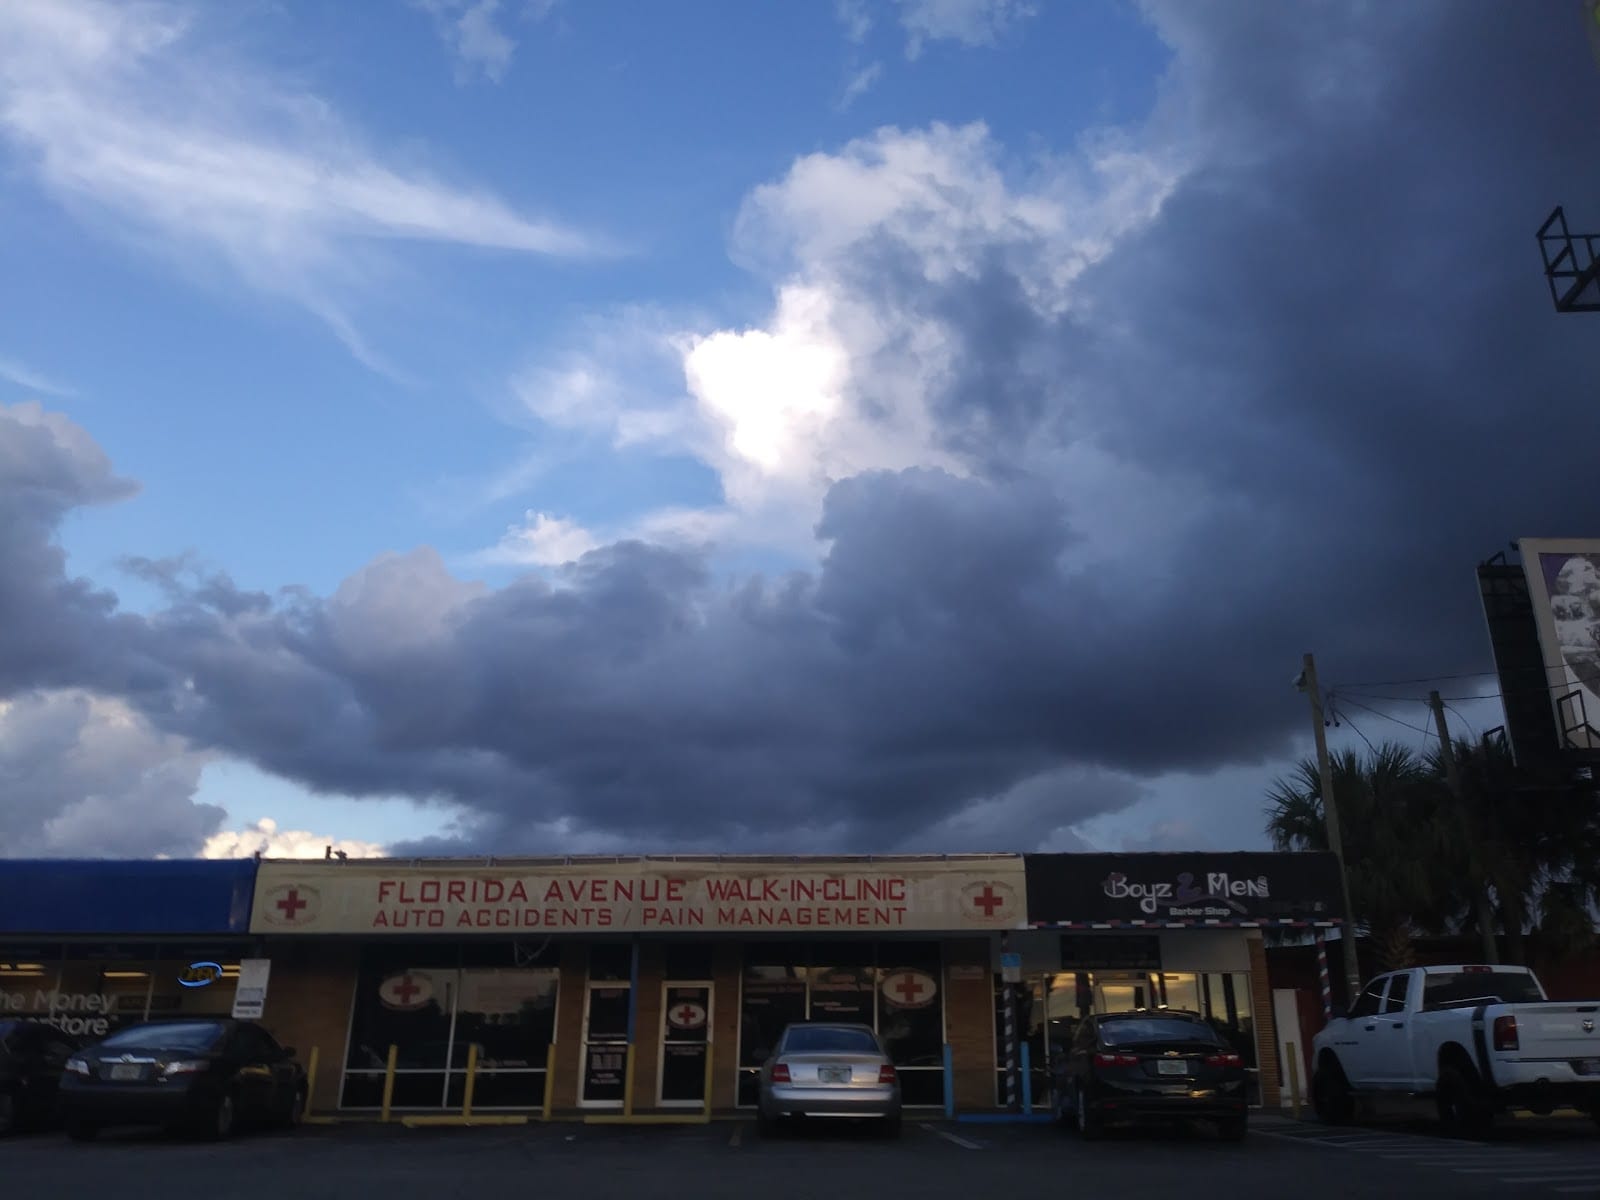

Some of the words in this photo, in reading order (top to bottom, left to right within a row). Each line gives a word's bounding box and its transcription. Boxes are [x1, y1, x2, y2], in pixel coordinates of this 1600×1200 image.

[378, 880, 528, 904] FLORIDA
[543, 879, 686, 902] AVENUE
[706, 878, 906, 901] WALK-IN-CLINIC
[1103, 872, 1173, 914] Boyz
[373, 909, 444, 928] AUTO
[456, 908, 613, 927] ACCIDENTS
[642, 908, 704, 926] PAIN
[717, 907, 908, 926] MANAGEMENT
[1169, 906, 1203, 917] Barber
[1204, 906, 1231, 918] Shop
[32, 989, 118, 1014] Money
